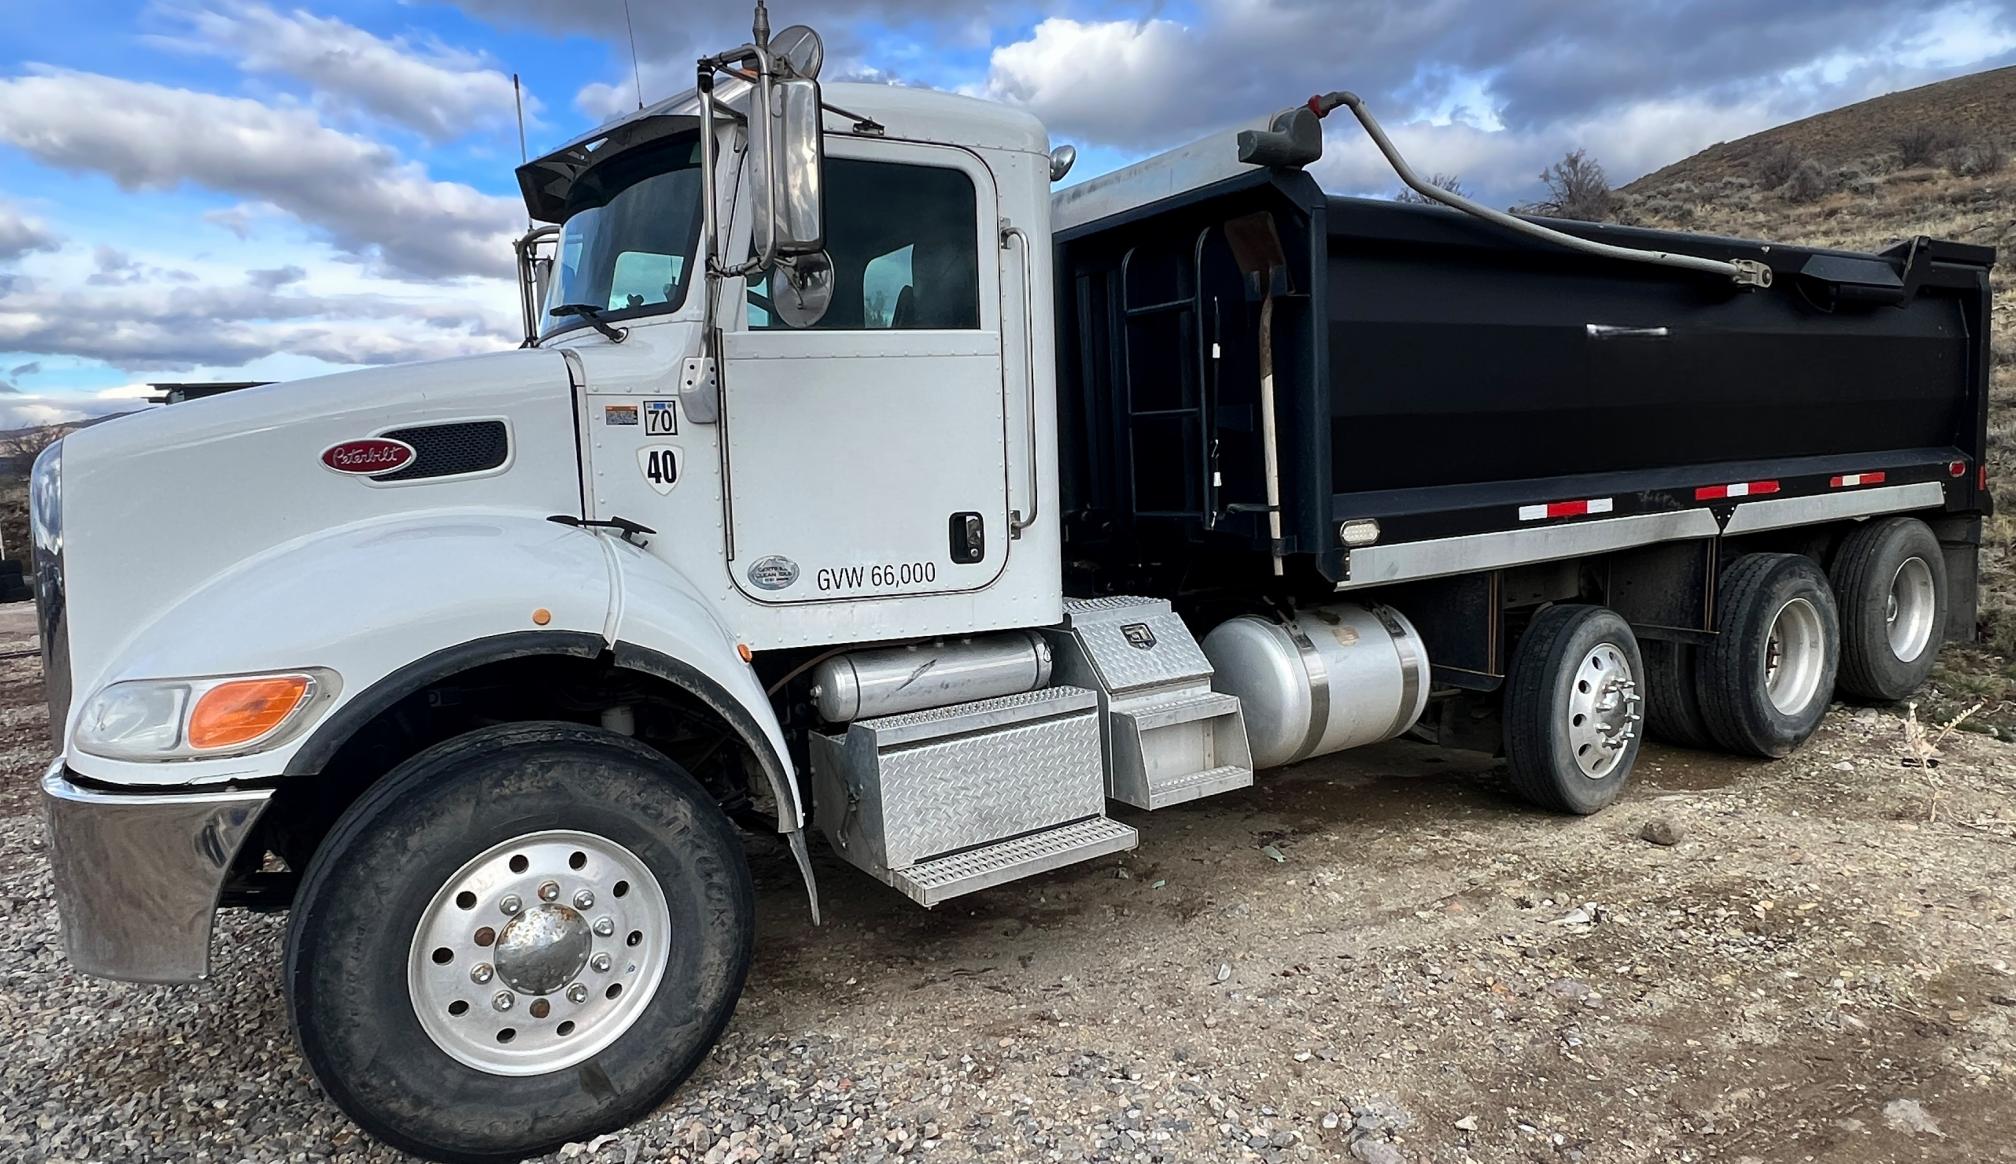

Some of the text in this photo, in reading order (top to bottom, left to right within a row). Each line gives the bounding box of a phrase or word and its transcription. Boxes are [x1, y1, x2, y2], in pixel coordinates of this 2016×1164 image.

[648, 410, 673, 432] 70
[333, 447, 402, 468] Peterbilt
[647, 450, 677, 484] 40
[817, 562, 936, 591] GVW 66,000
